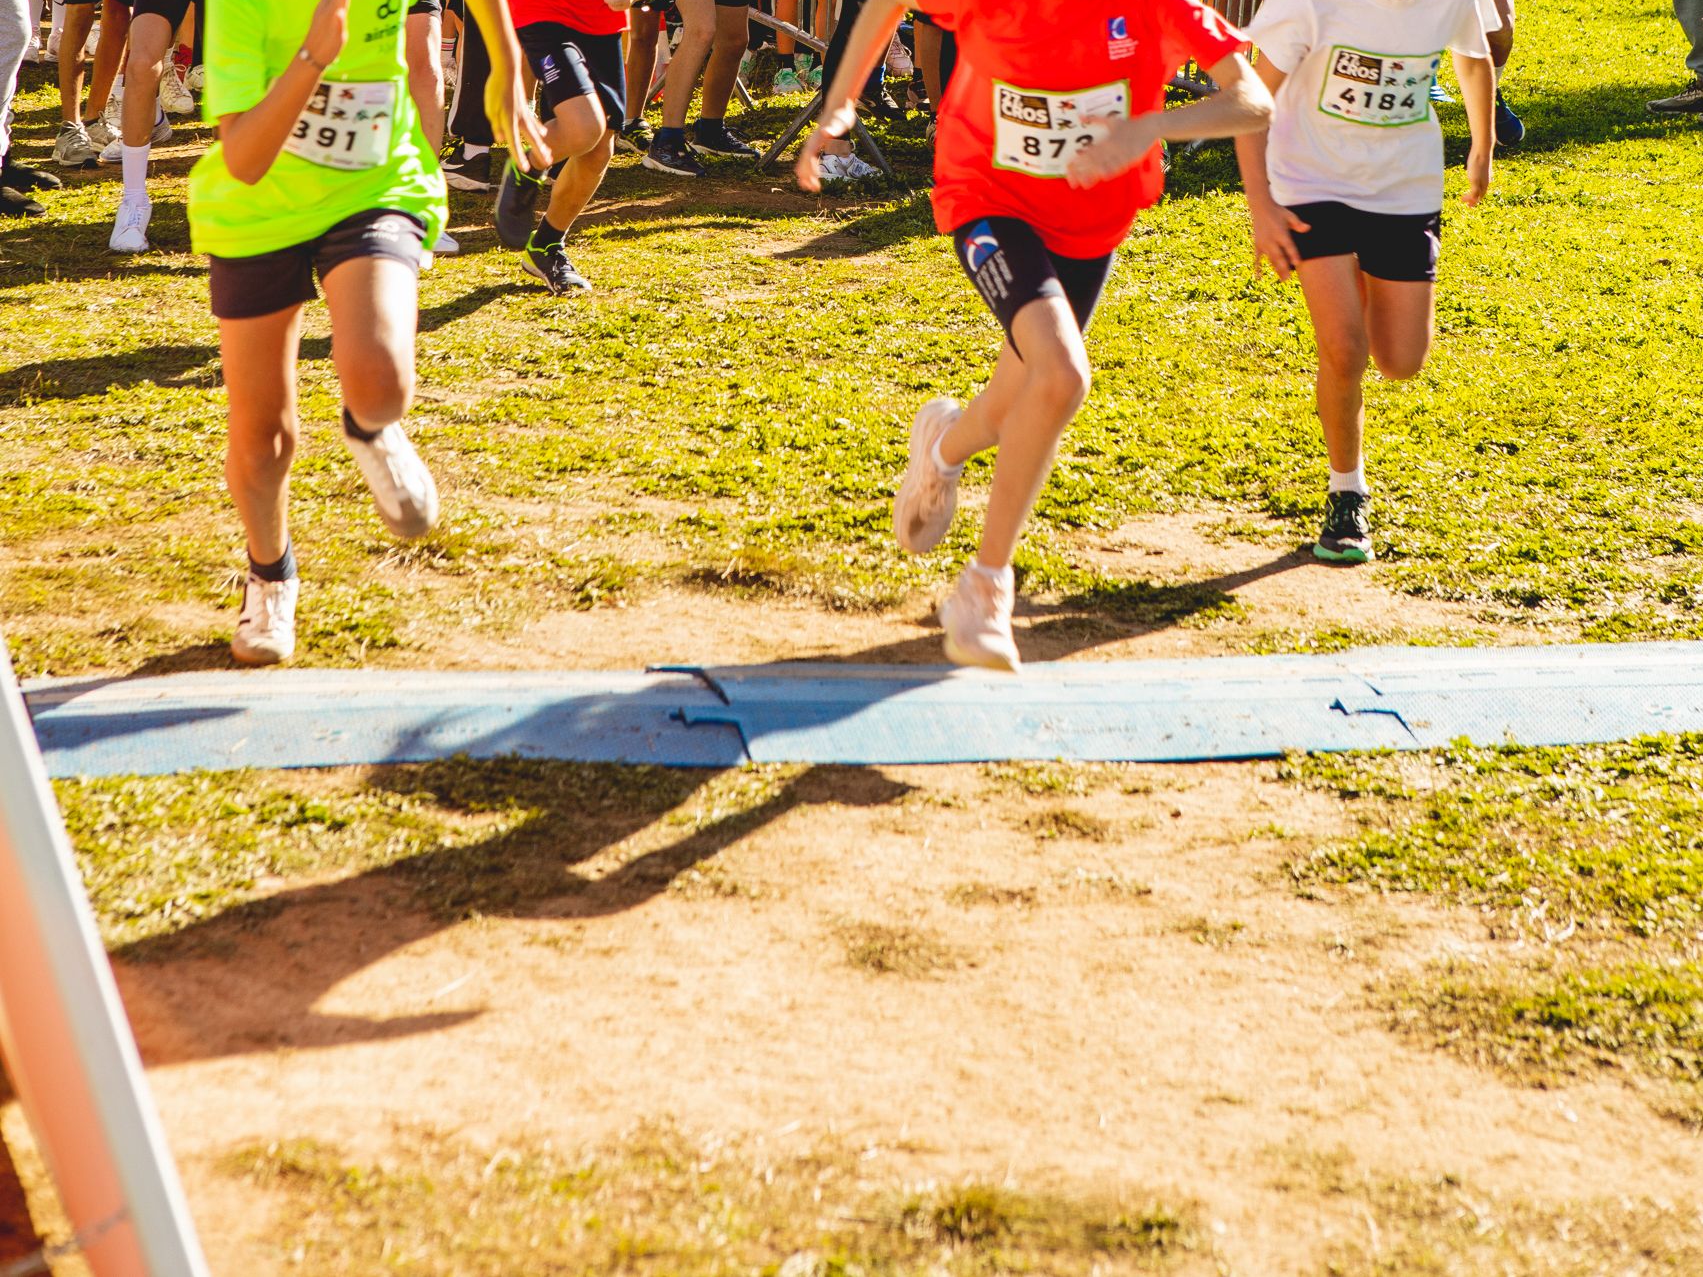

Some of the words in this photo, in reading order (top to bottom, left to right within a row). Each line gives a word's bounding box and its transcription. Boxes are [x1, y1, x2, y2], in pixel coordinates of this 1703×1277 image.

[1336, 59, 1380, 81] CROS
[1339, 87, 1416, 111] 4184
[1001, 100, 1049, 124] CROS
